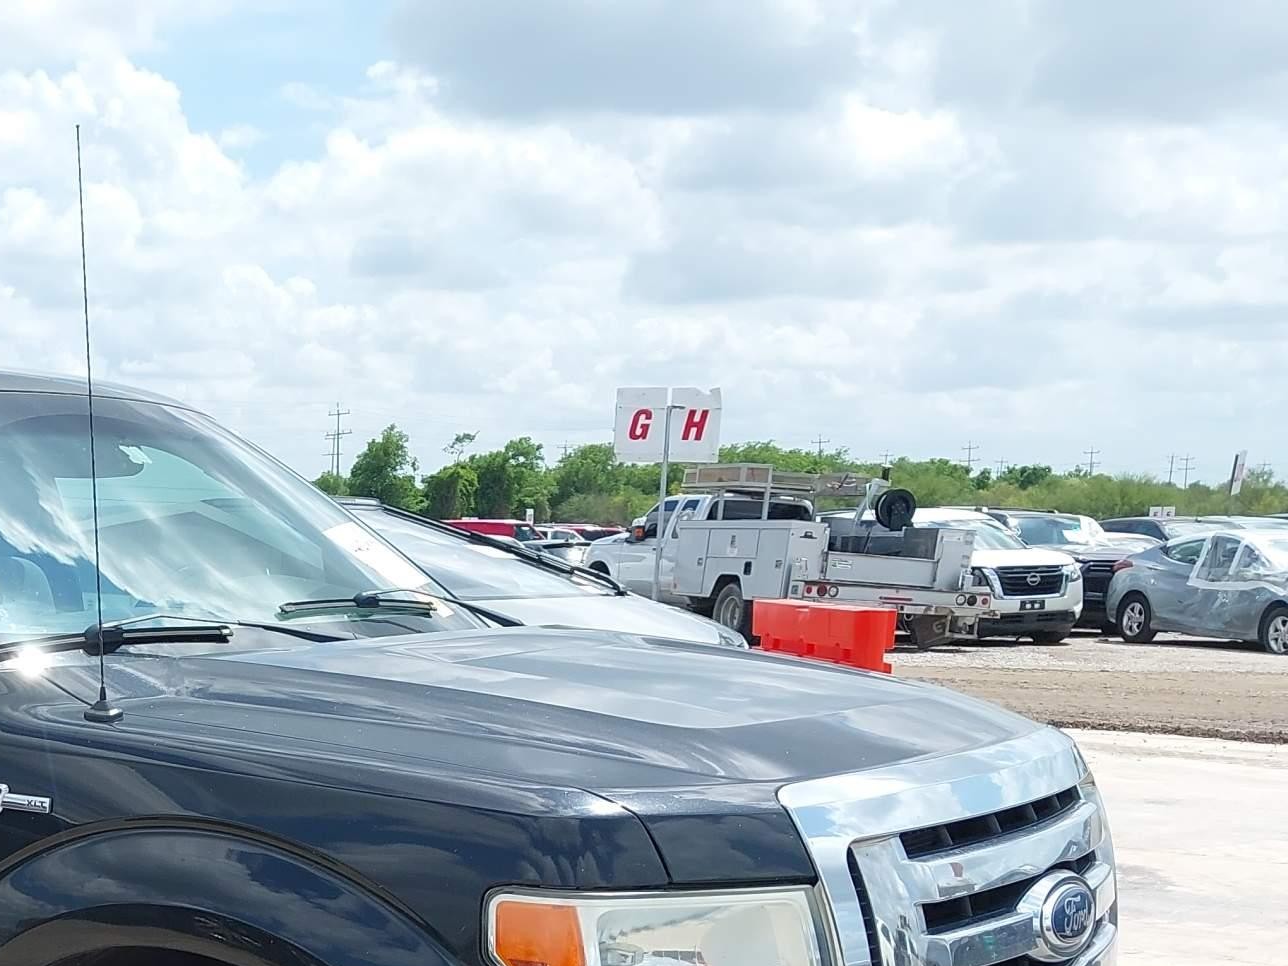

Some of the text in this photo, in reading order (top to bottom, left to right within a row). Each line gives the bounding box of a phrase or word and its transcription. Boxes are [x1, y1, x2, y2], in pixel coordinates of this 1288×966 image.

[628, 408, 653, 441] G
[681, 409, 710, 441] H
[25, 798, 49, 809] XLT
[1063, 894, 1091, 936] Ford
